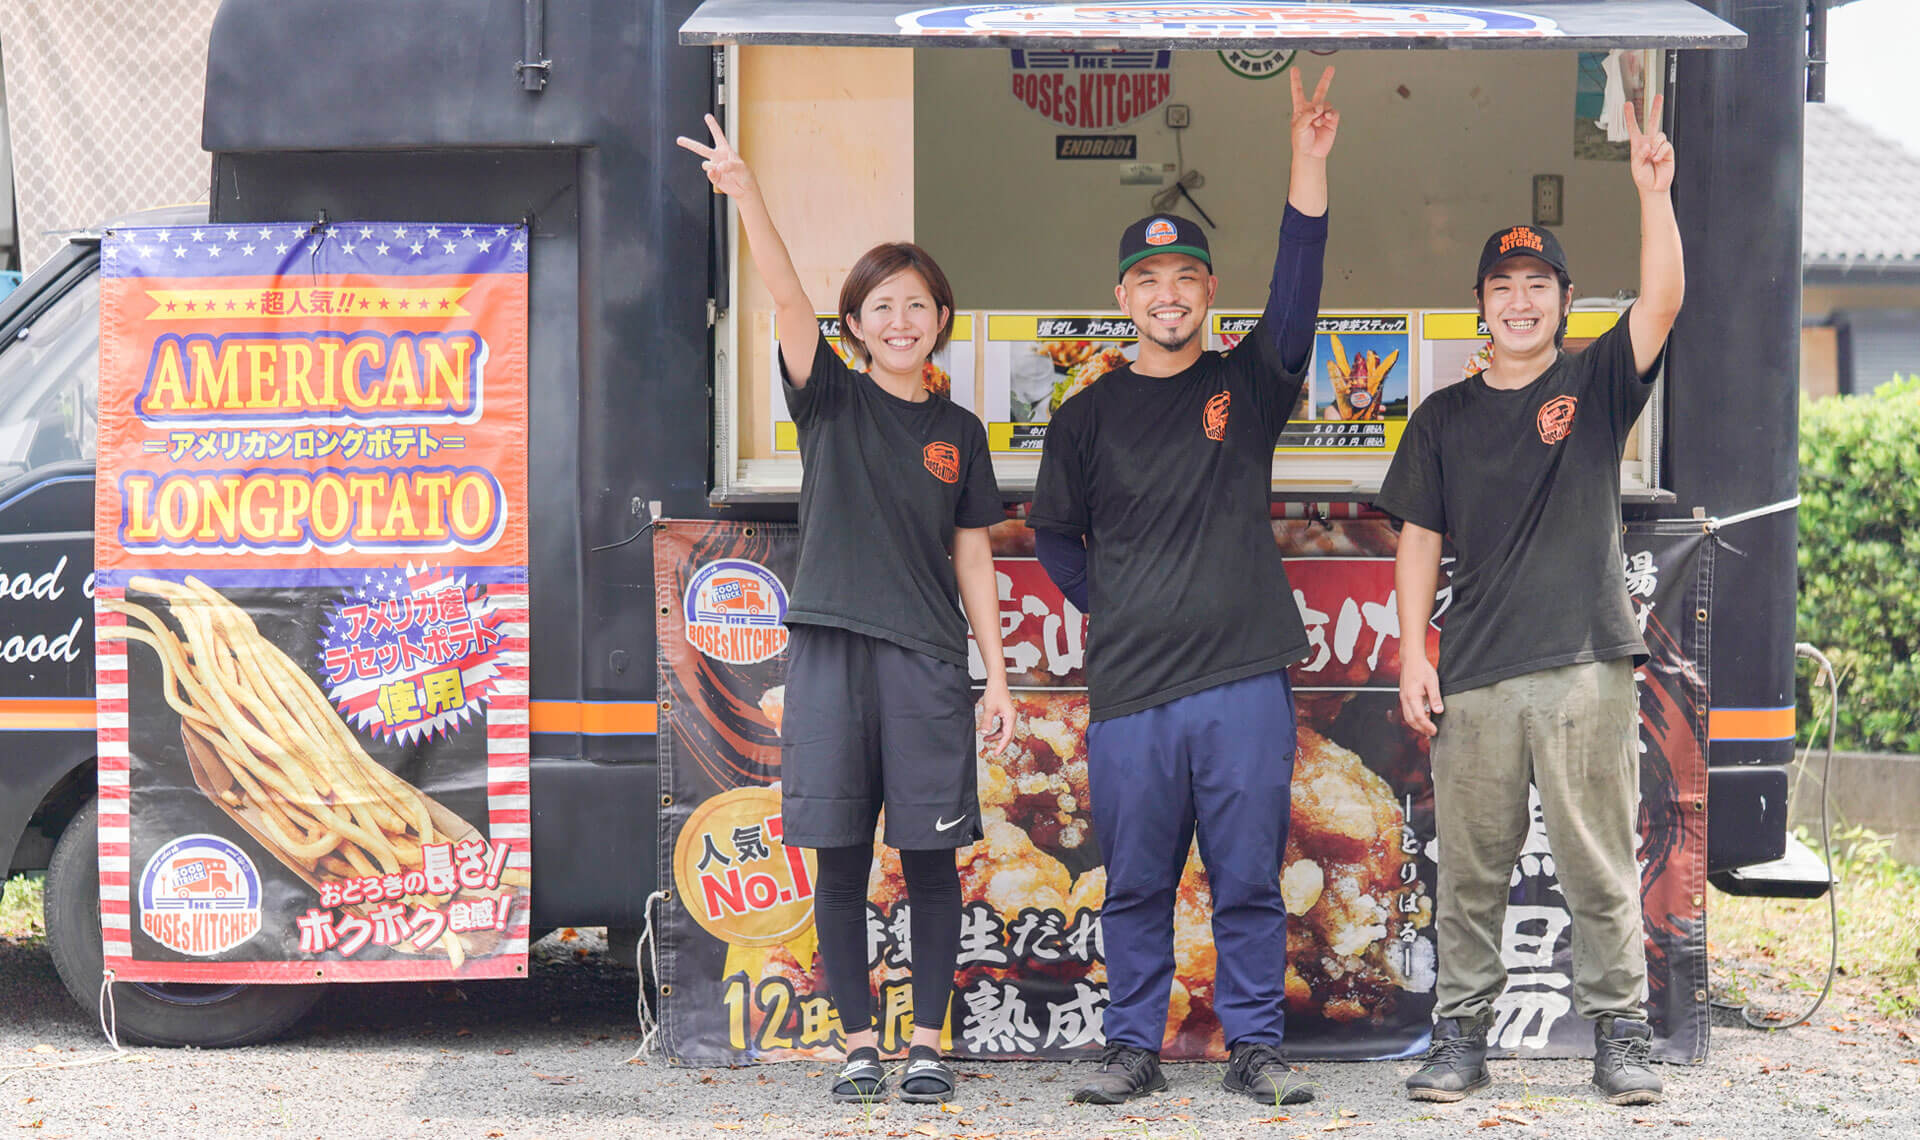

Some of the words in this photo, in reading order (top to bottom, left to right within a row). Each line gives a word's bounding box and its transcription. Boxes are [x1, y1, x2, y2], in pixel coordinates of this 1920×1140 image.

[1074, 52, 1109, 69] THE
[146, 340, 473, 410] AMERICAN
[169, 429, 441, 461] アメリカンロングポテト
[127, 476, 492, 539] LONGPOTATO
[342, 588, 469, 642] アメリカ産
[726, 614, 748, 624] THE
[324, 619, 499, 685] ラセットポテト
[376, 668, 465, 728] 使用
[697, 825, 770, 872] 人気
[188, 899, 215, 909] THE
